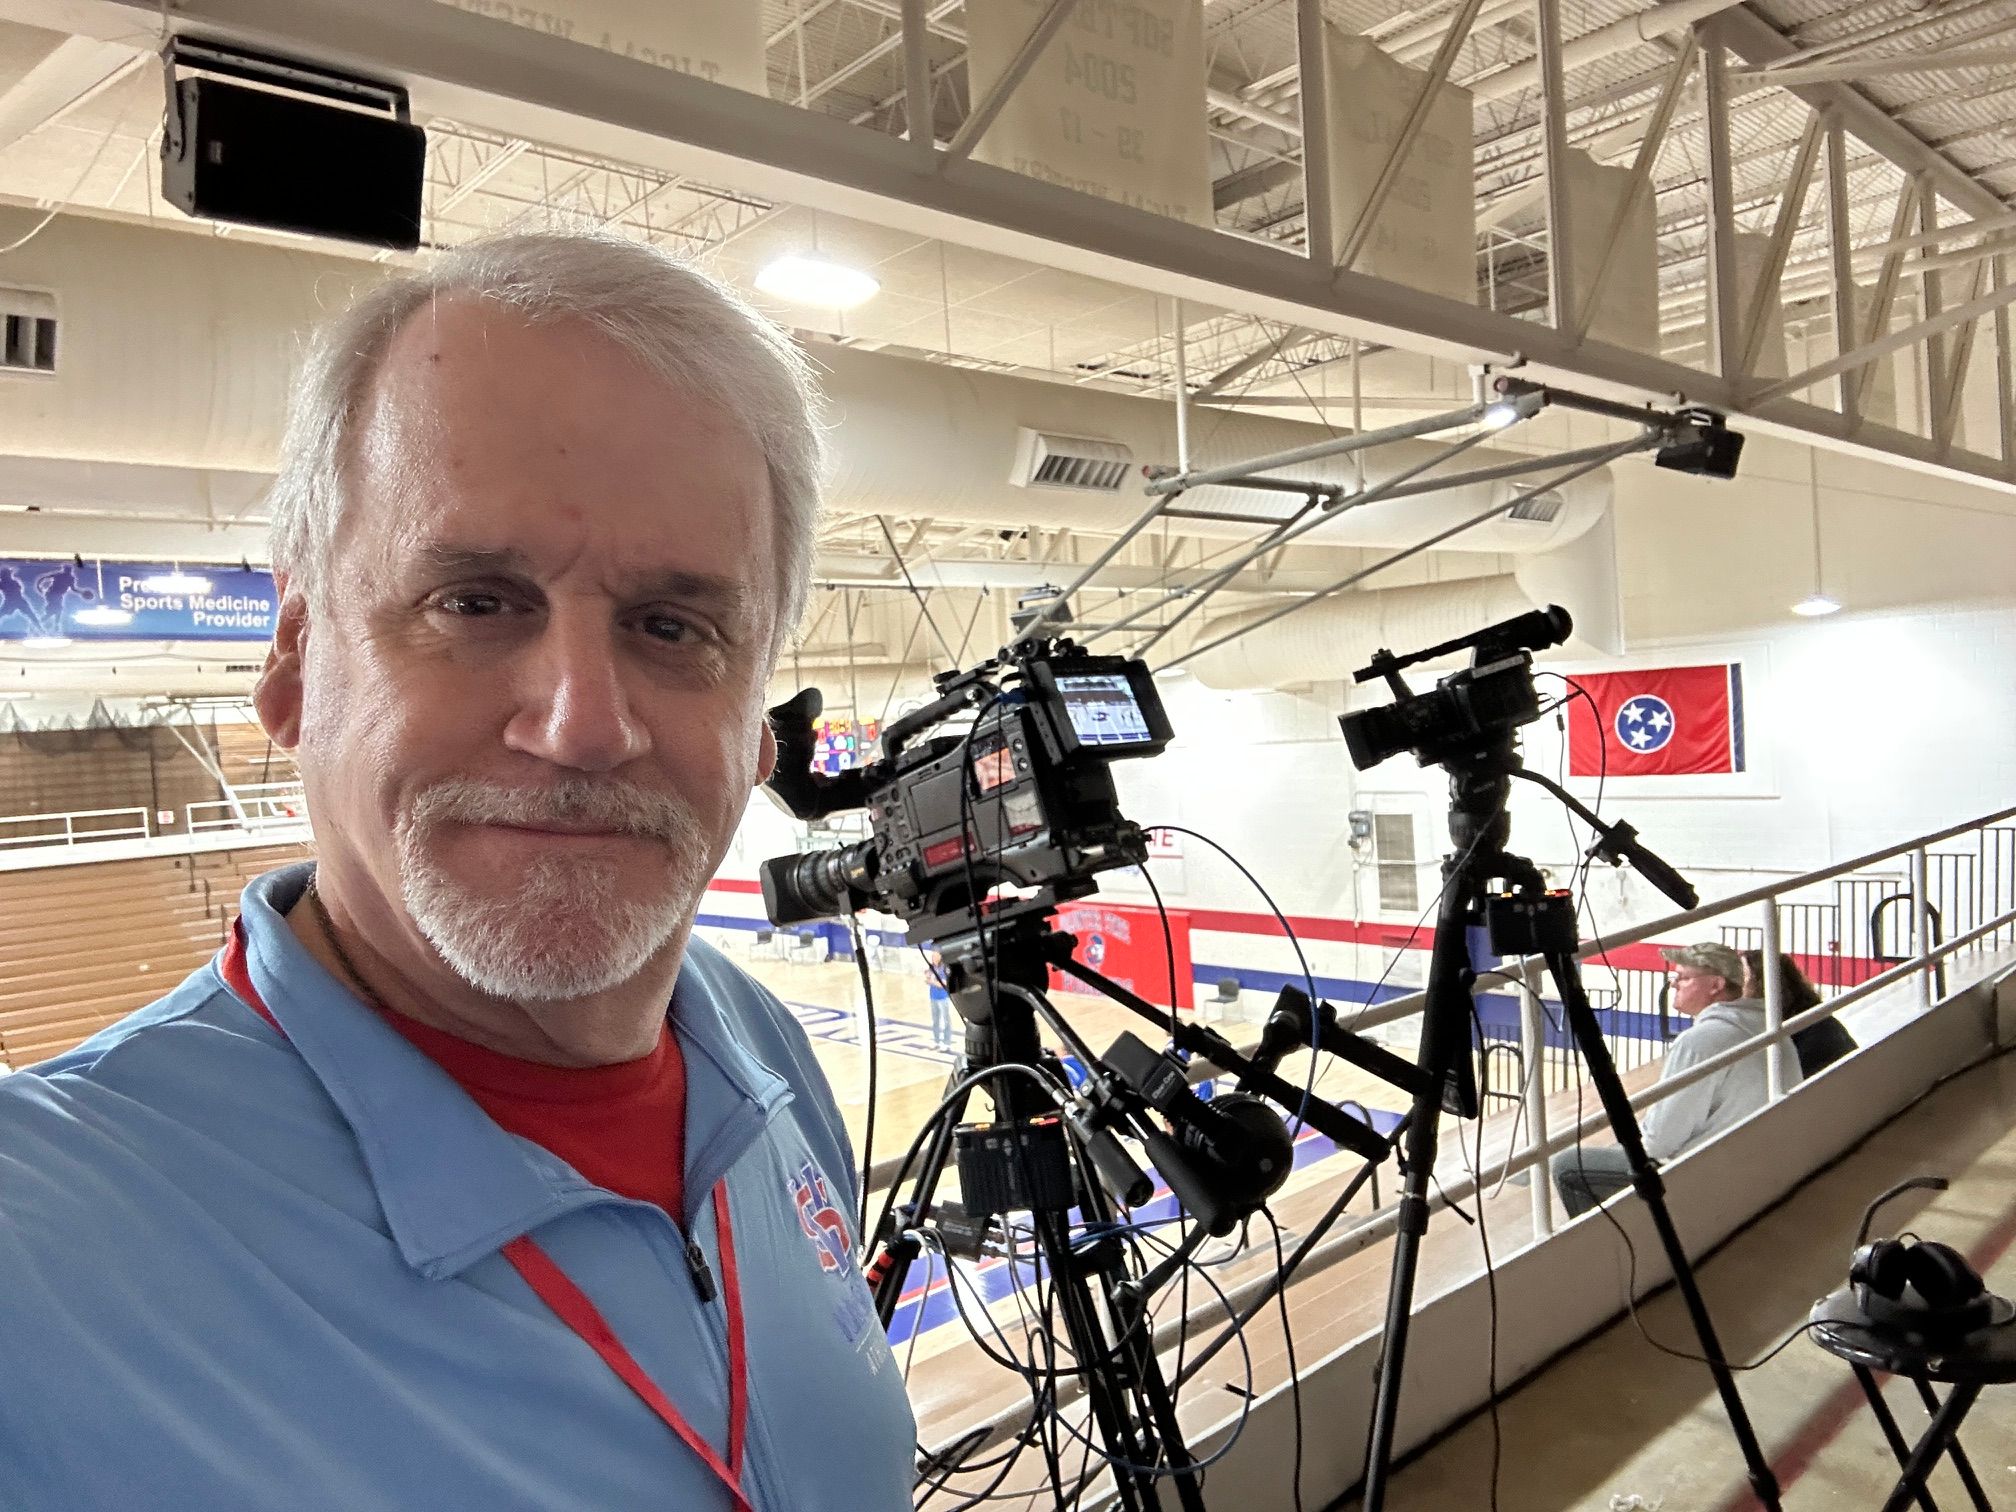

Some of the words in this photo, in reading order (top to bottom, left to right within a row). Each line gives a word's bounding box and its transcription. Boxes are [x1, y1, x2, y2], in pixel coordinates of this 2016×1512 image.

[120, 593, 183, 612] Sports
[189, 595, 270, 612] Medicine
[194, 611, 270, 628] Provider
